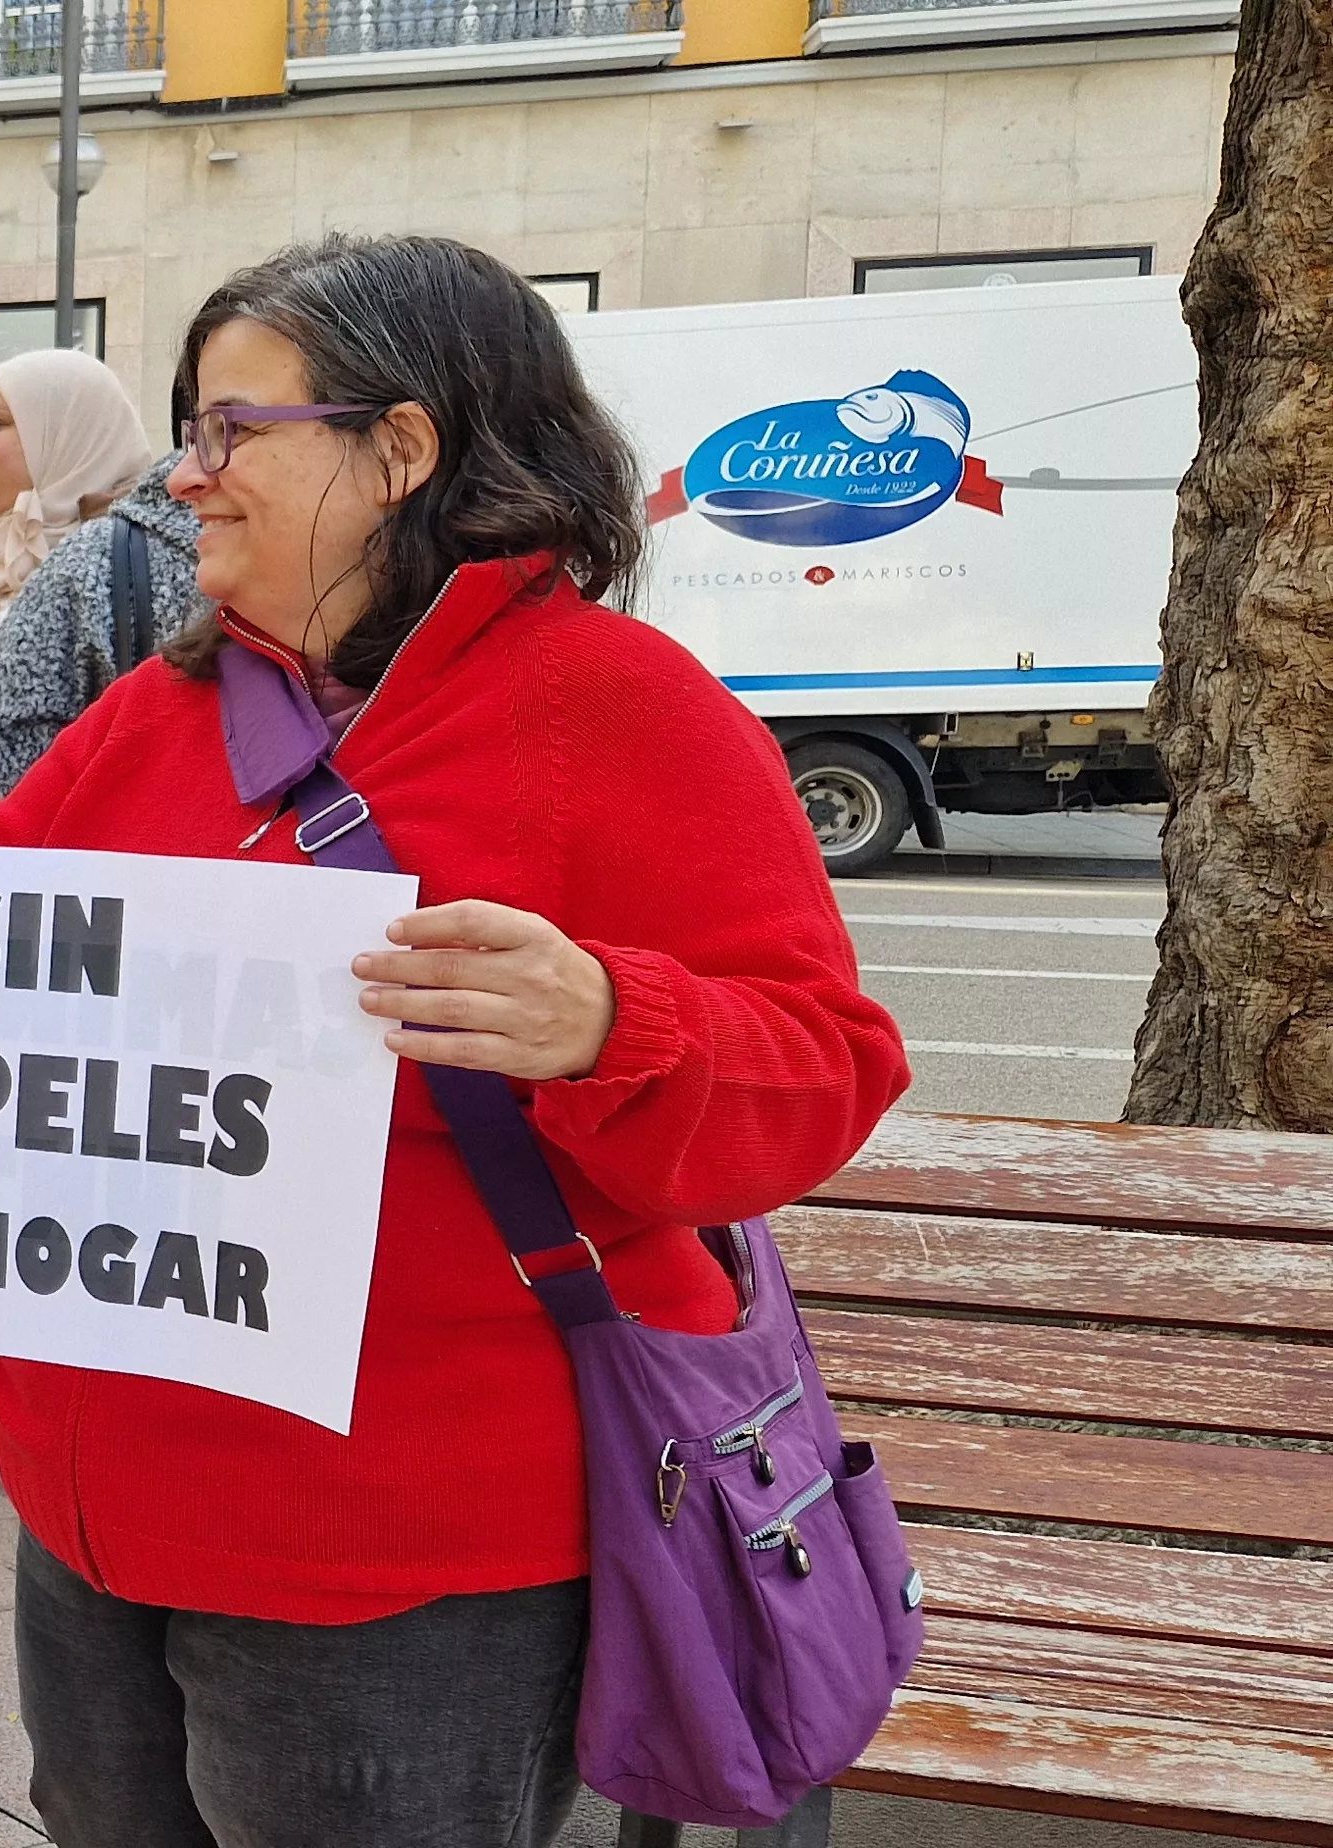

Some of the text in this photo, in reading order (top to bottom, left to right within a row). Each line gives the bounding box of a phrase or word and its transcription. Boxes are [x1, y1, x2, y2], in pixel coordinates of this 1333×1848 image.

[755, 420, 802, 450] La
[719, 439, 920, 483] Coruñesa
[845, 480, 917, 496] Desde 1922
[673, 569, 798, 588] PESCADOS
[841, 563, 968, 581] MARISCOS
